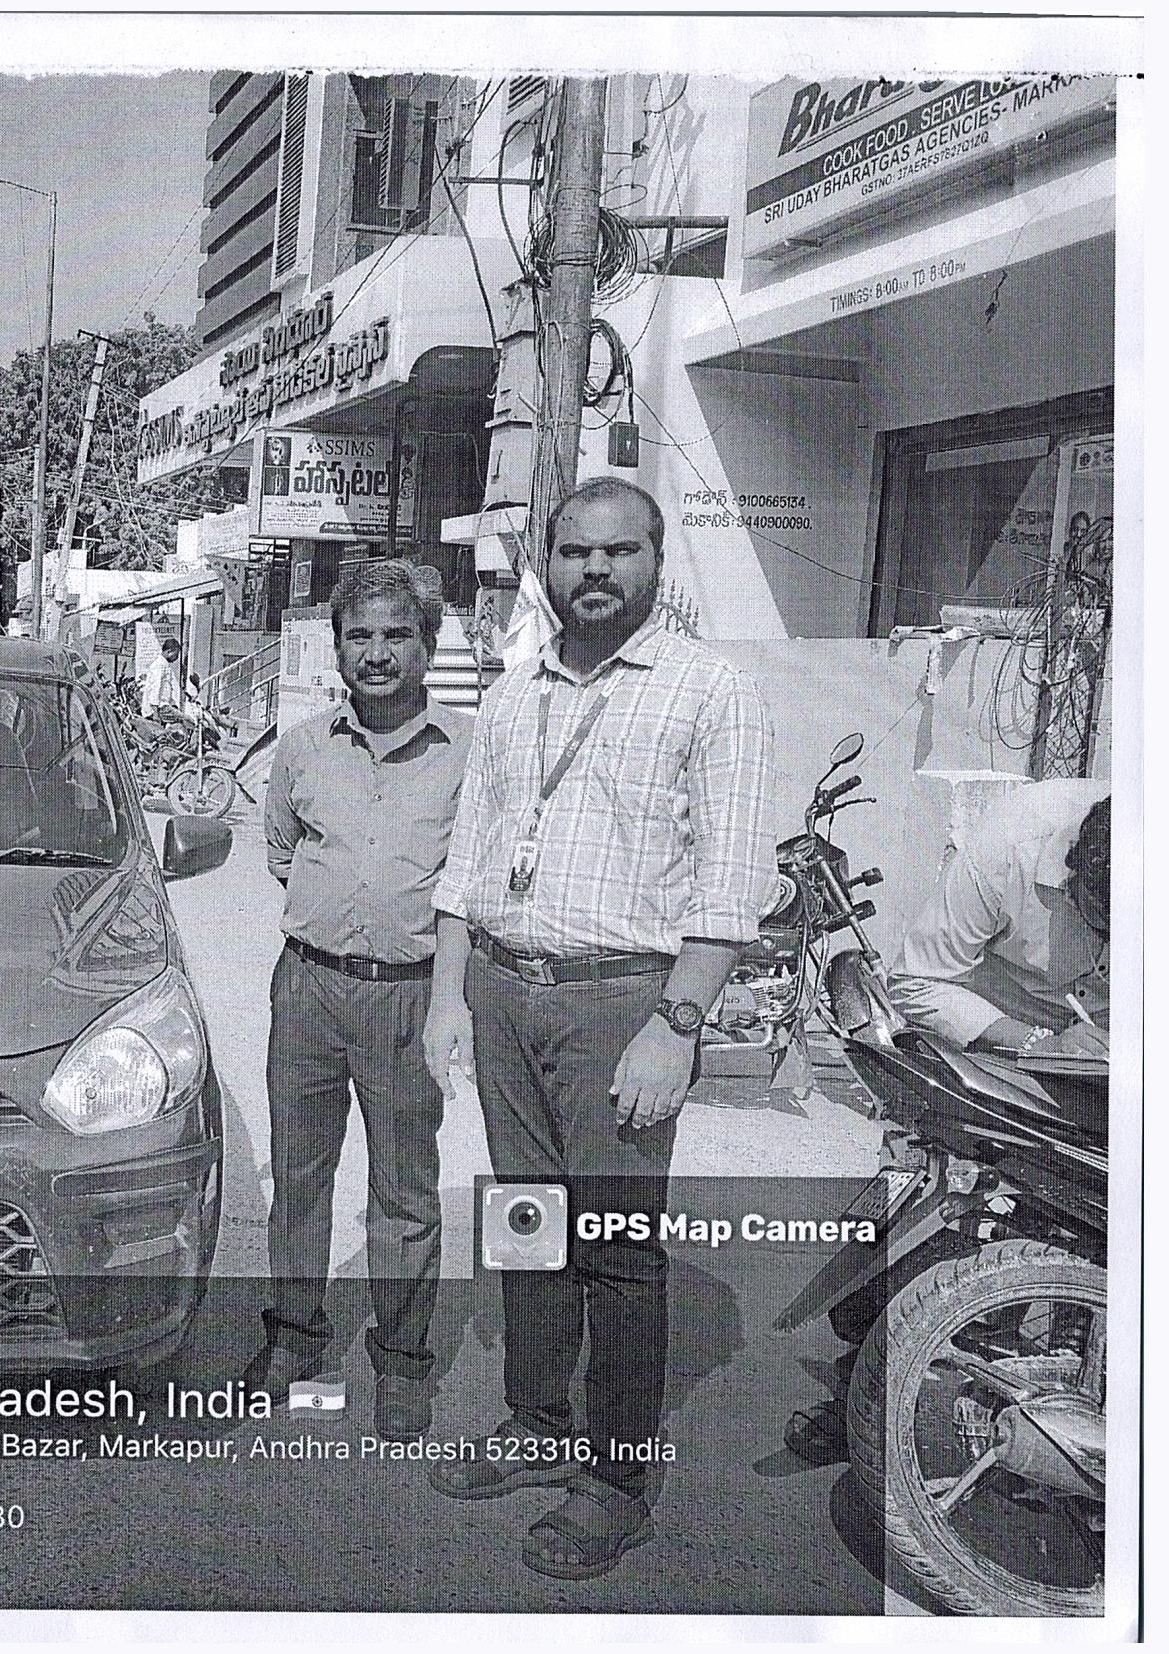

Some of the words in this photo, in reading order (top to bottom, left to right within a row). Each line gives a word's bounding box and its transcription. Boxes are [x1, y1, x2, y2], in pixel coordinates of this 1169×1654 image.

[823, 140, 865, 176] COOK
[920, 84, 976, 130] SERVE
[763, 202, 784, 224] SRI
[787, 185, 821, 214] UDAY
[823, 143, 911, 198] BHARATGAS
[829, 287, 873, 313] TIMINGS:
[912, 268, 926, 288] TO
[324, 439, 376, 457] SSIMS
